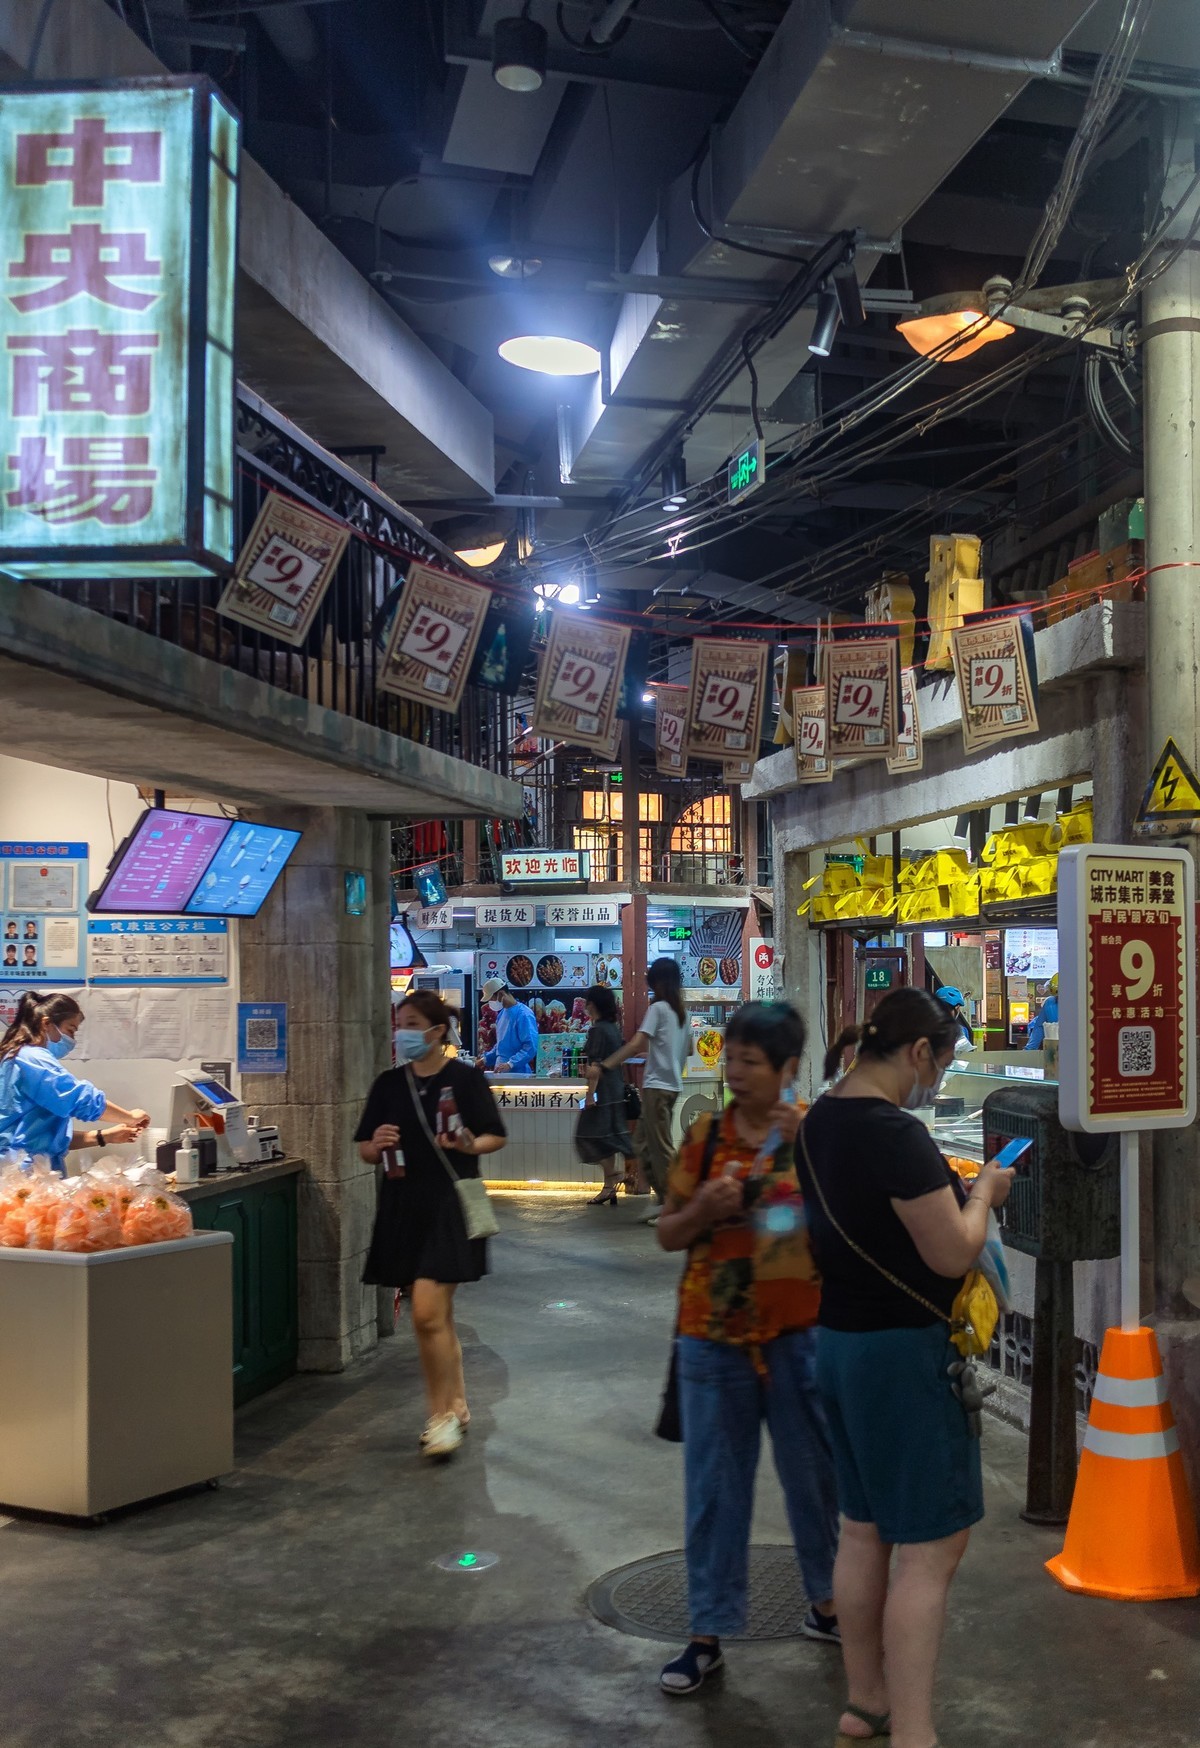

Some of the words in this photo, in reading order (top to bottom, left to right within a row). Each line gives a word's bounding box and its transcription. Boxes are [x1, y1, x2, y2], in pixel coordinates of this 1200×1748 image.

[8, 118, 163, 527] 中央商場
[264, 554, 304, 584] 9
[415, 622, 450, 653] 9
[565, 665, 596, 697] 9
[983, 664, 1004, 699] 9
[1001, 684, 1013, 697] 折
[712, 686, 740, 717] 9
[848, 684, 873, 717] 9
[867, 706, 880, 718] 折
[665, 719, 678, 743] 9
[807, 722, 820, 749] 9
[505, 857, 577, 875] 欢迎光临
[1090, 869, 1113, 882] CITY
[1115, 870, 1144, 882] MART
[1149, 870, 1175, 887] 美食
[1091, 885, 1144, 904] 城市集市
[1149, 888, 1175, 904] 弄堂
[421, 911, 448, 924] 财务处
[484, 908, 527, 922] 提货处
[551, 907, 610, 921] 荣誉出品
[1102, 910, 1169, 924] 居民朋友们
[110, 921, 206, 931] 健康证公示栏
[1101, 935, 1122, 945] 新会员
[872, 971, 885, 982] 18
[1111, 984, 1122, 998] 享
[1120, 939, 1155, 1000] 9
[1153, 984, 1163, 997] 折
[757, 974, 774, 986] 夸父
[1112, 1006, 1164, 1019] 优惠活动
[497, 1091, 579, 1107] 本卤油香不
